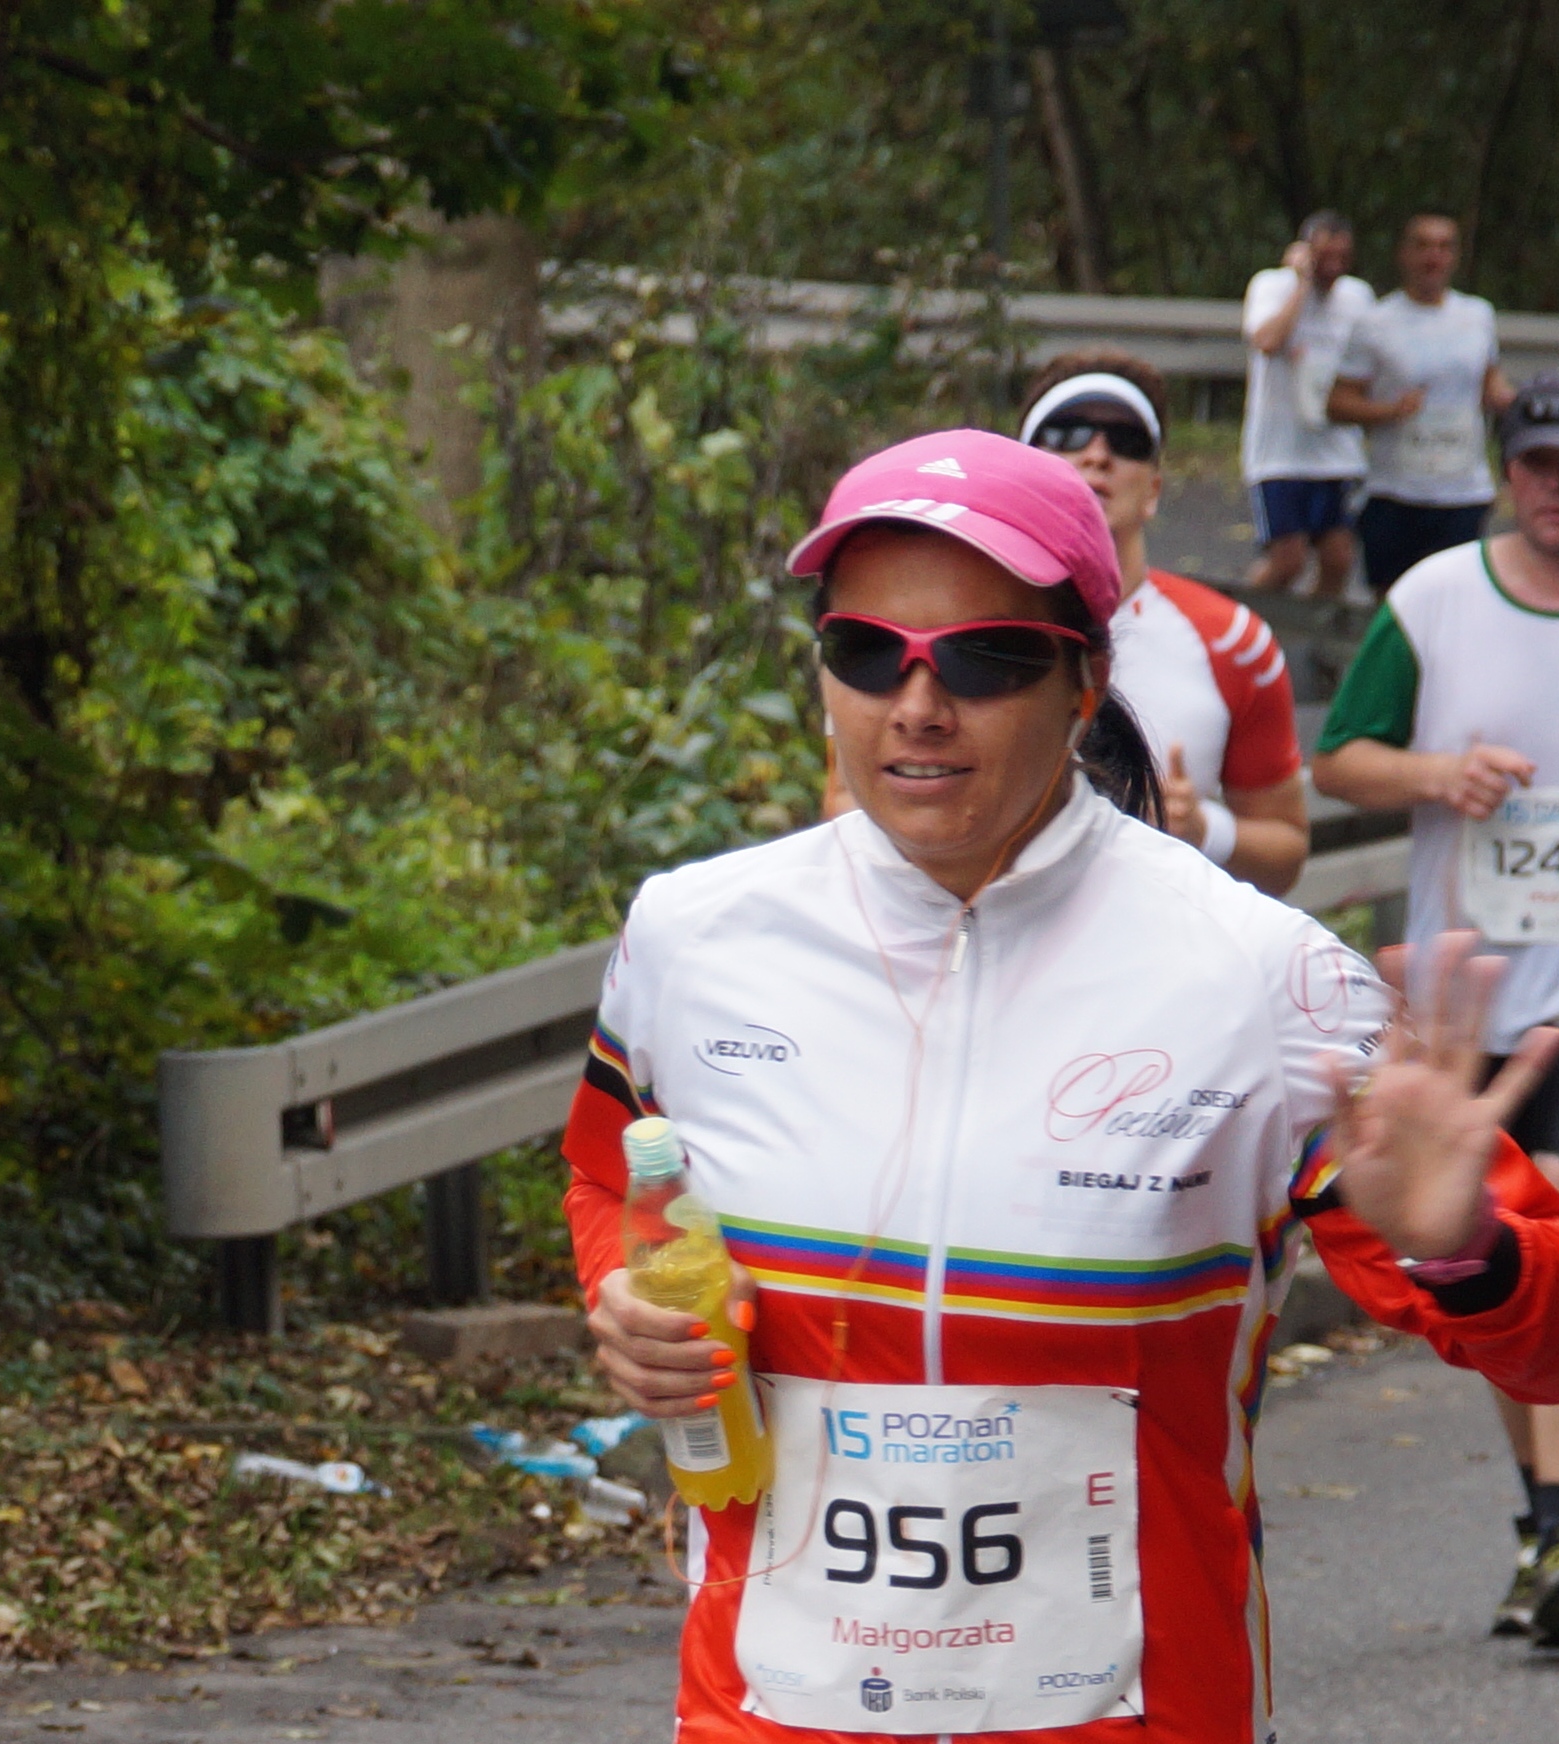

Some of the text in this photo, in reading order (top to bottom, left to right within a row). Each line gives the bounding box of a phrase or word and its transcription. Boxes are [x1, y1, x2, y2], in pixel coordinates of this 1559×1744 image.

[704, 1039, 787, 1062] VEZUVIO
[1058, 1170, 1140, 1191] BIEGAJ
[1147, 1174, 1165, 1192] Z
[821, 1406, 871, 1460] 15
[882, 1438, 1016, 1464] maraton
[1087, 1472, 1115, 1506] E
[824, 1498, 1023, 1590] 956
[831, 1616, 1016, 1655] Małgorzata
